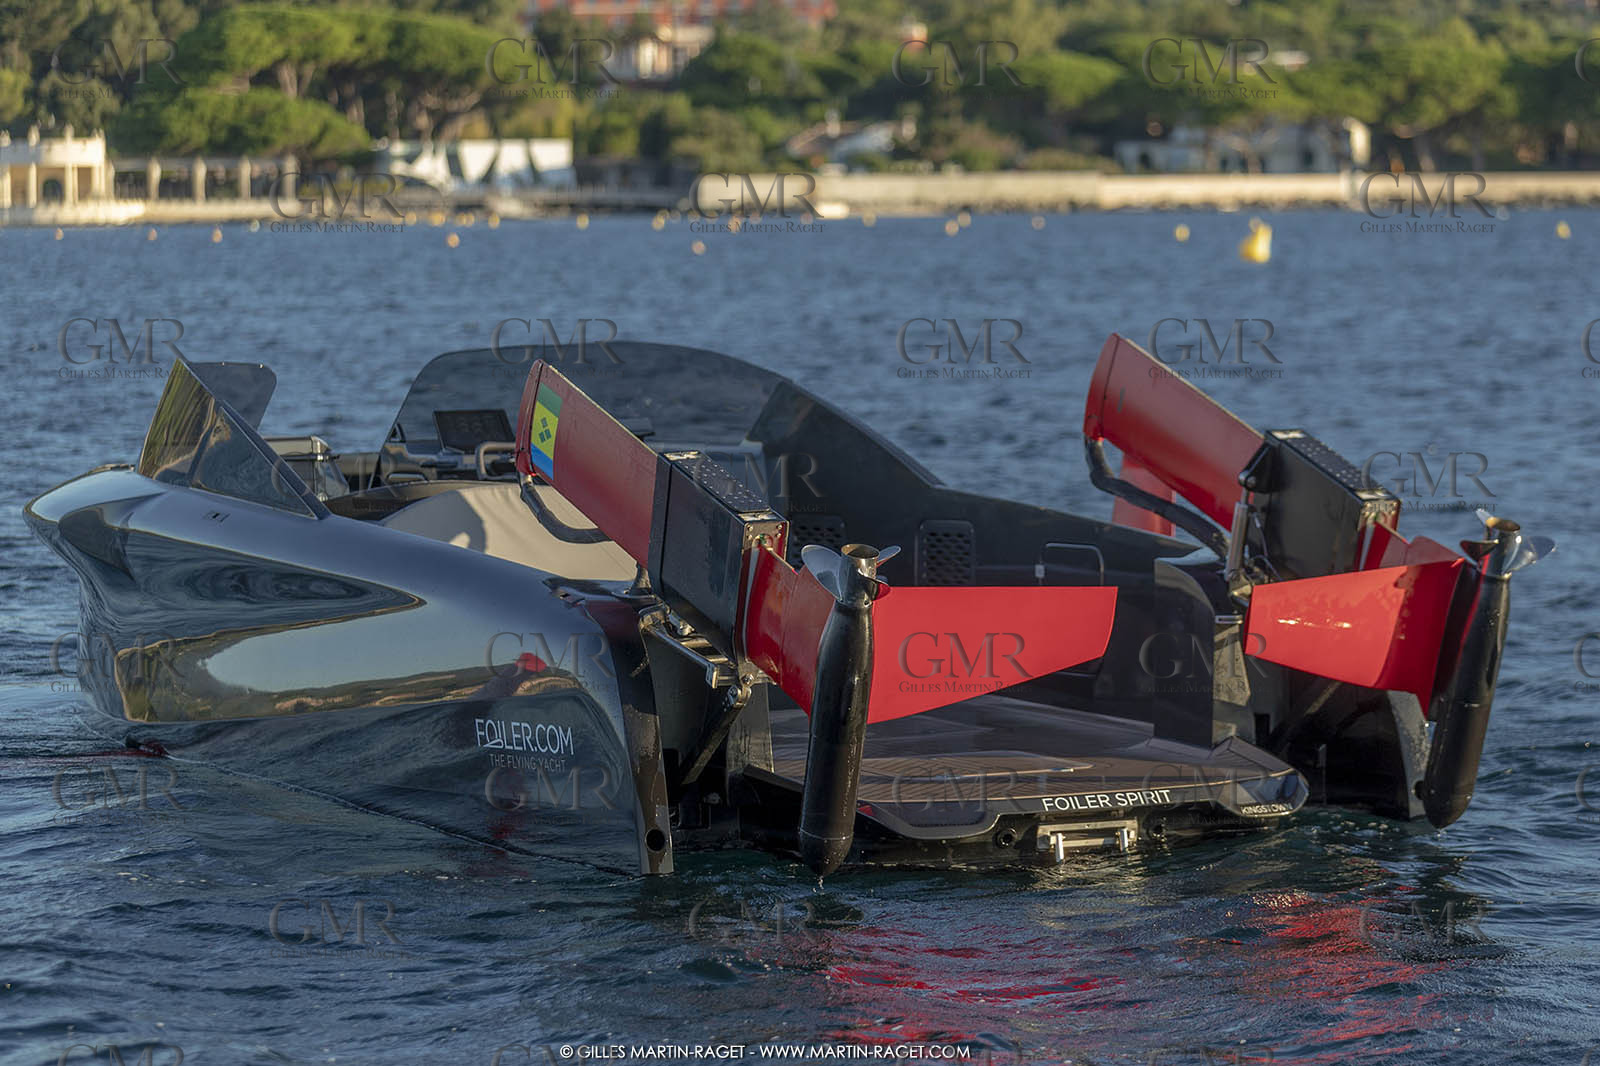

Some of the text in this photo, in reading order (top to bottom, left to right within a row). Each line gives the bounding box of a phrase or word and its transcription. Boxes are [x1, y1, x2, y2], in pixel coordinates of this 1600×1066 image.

[489, 753, 567, 772] THE FLYING YACHT
[1042, 789, 1171, 812] FOILER SPIRIT
